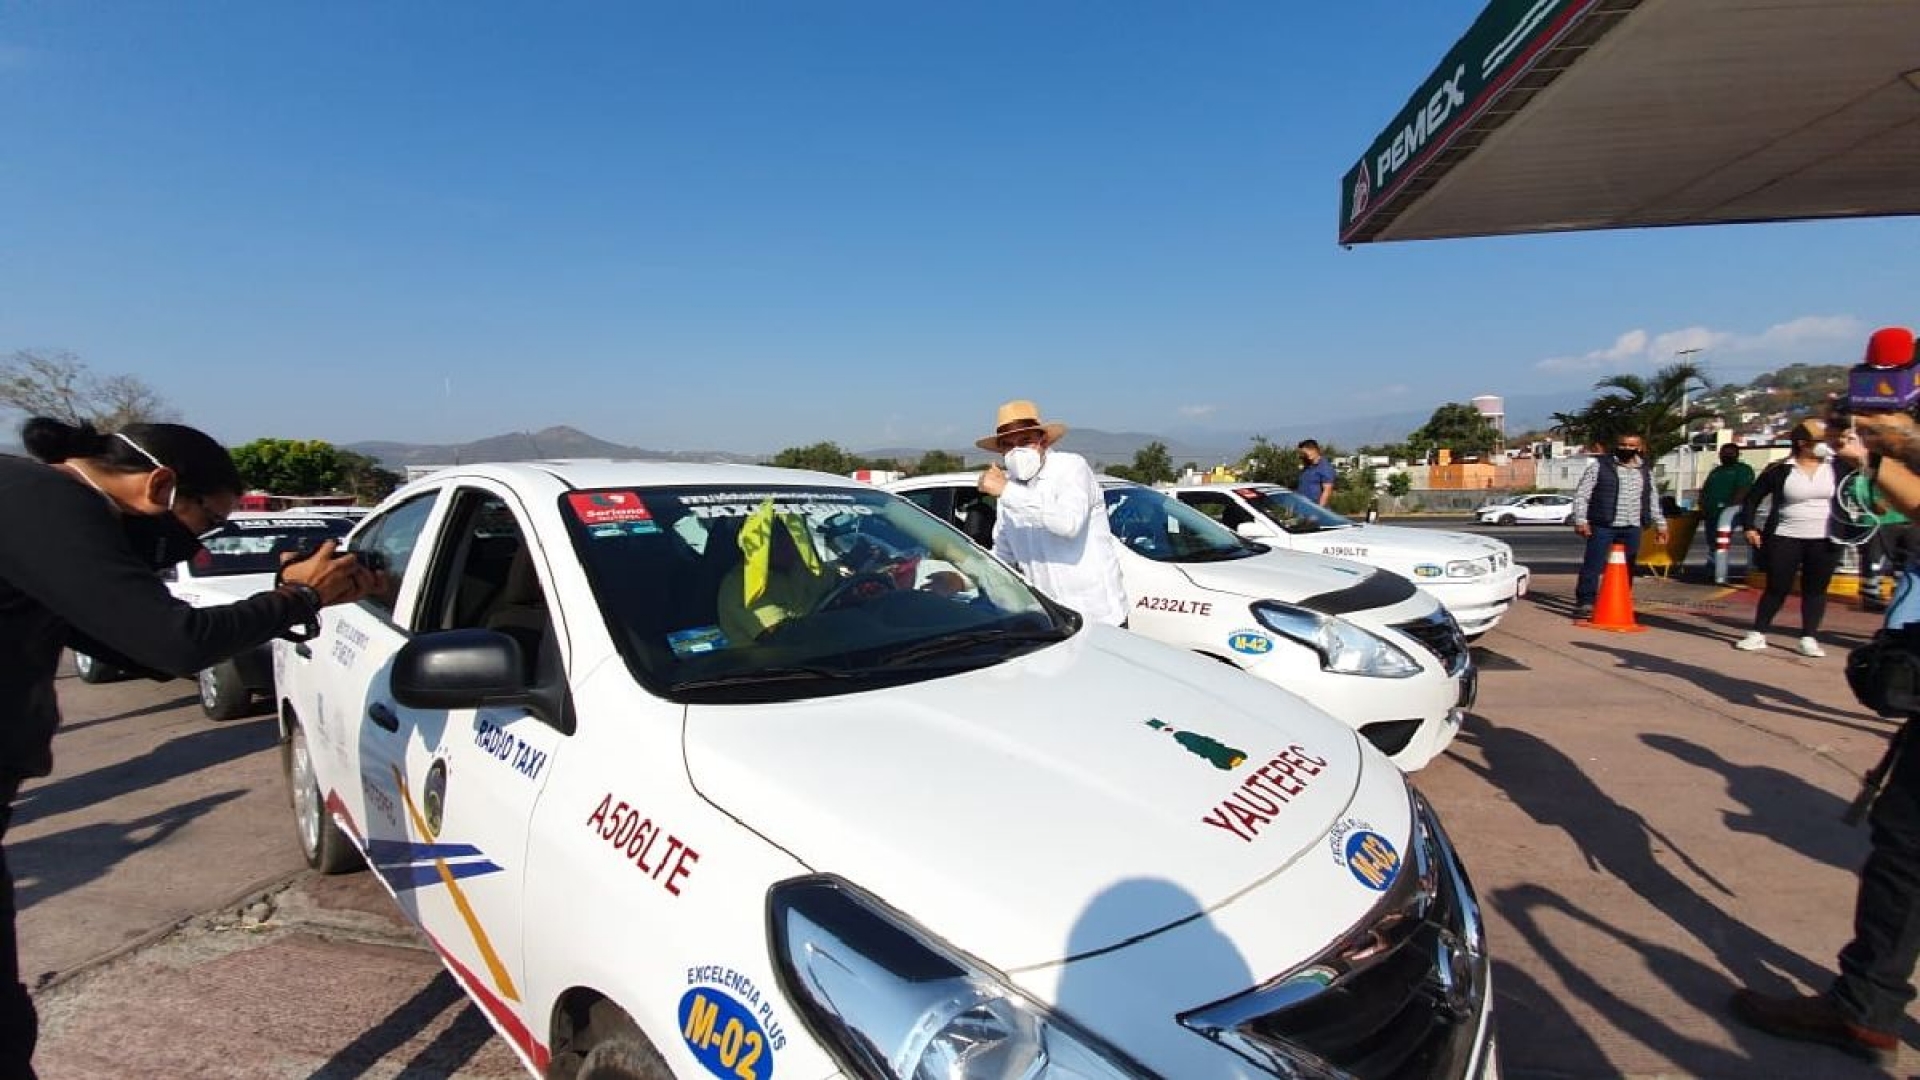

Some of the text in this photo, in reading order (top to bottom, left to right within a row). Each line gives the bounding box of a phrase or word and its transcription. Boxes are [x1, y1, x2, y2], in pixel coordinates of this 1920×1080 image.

[1377, 64, 1465, 188] PEMEX
[1135, 596, 1213, 616] A232LTE
[1234, 636, 1268, 652] M-42
[475, 719, 514, 761] RADIO
[511, 739, 548, 780] TAXI
[1202, 744, 1328, 842] YAUTEPEC
[587, 792, 700, 897] A506LTE
[684, 993, 764, 1080] M-02
[687, 964, 787, 1052] EXCELENCIA PLUS
